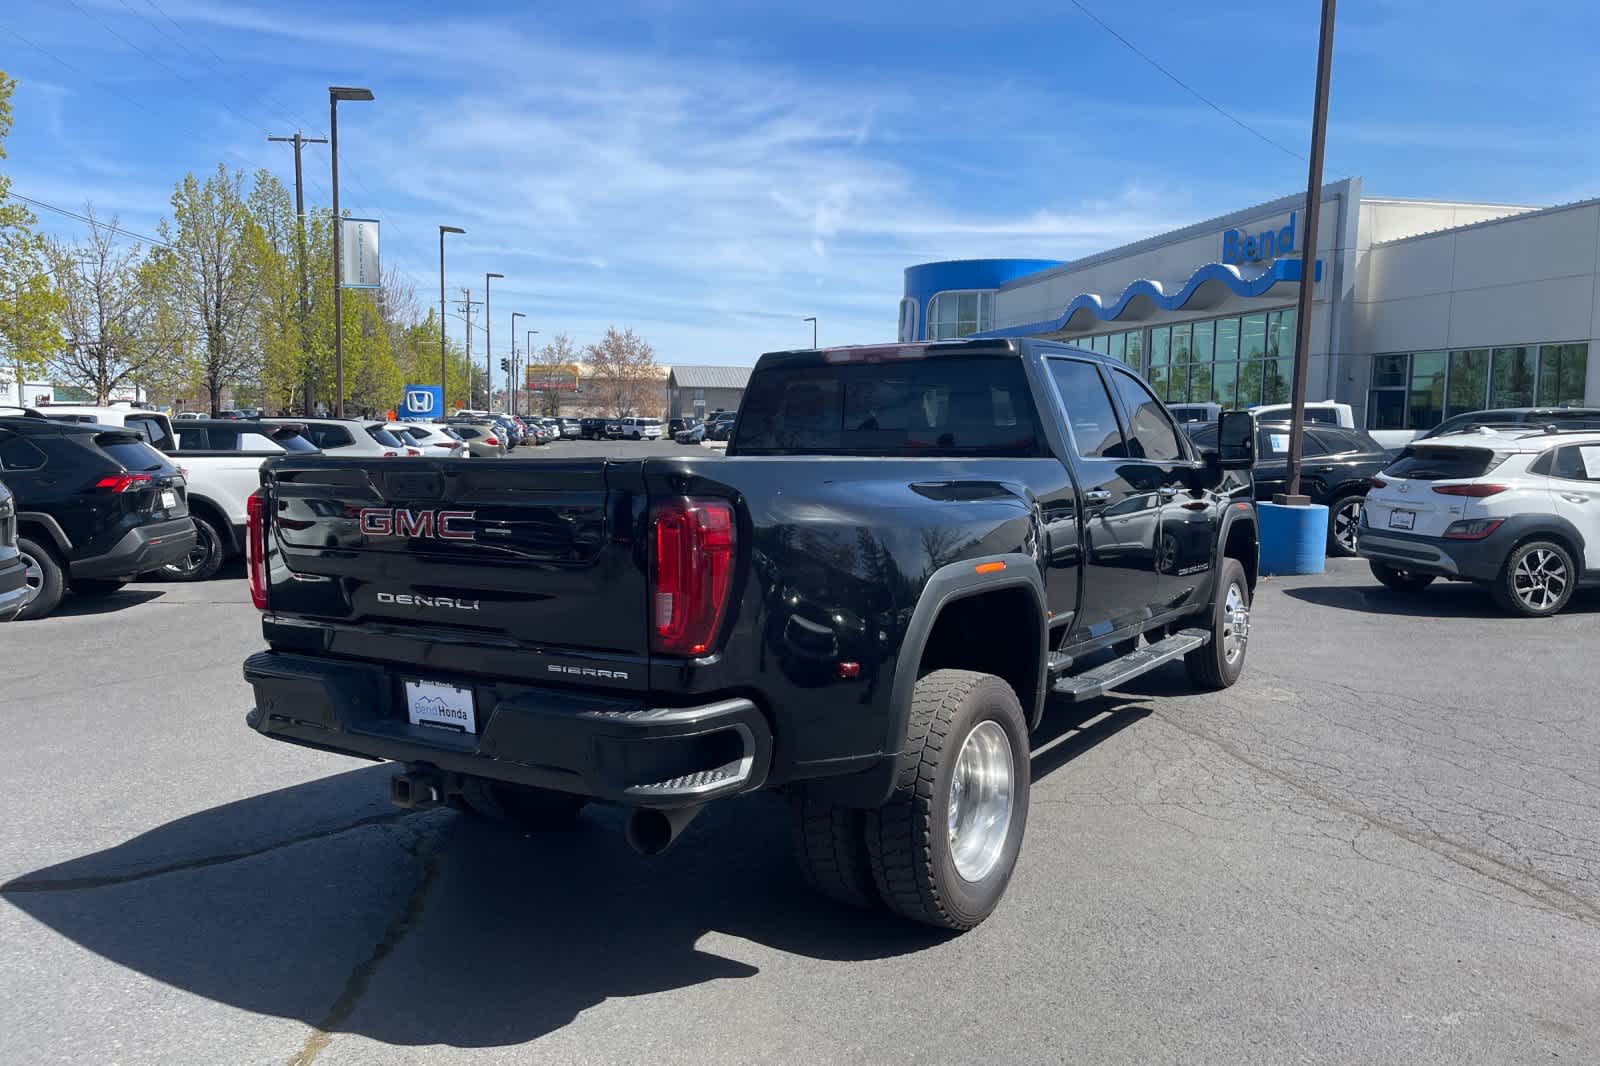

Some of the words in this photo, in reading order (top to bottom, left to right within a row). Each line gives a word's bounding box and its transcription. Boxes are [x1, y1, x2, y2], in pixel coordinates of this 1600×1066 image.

[1222, 211, 1296, 264] Bend
[360, 508, 476, 540] GMC
[377, 593, 480, 610] DENALI
[548, 665, 629, 679] SIERRA
